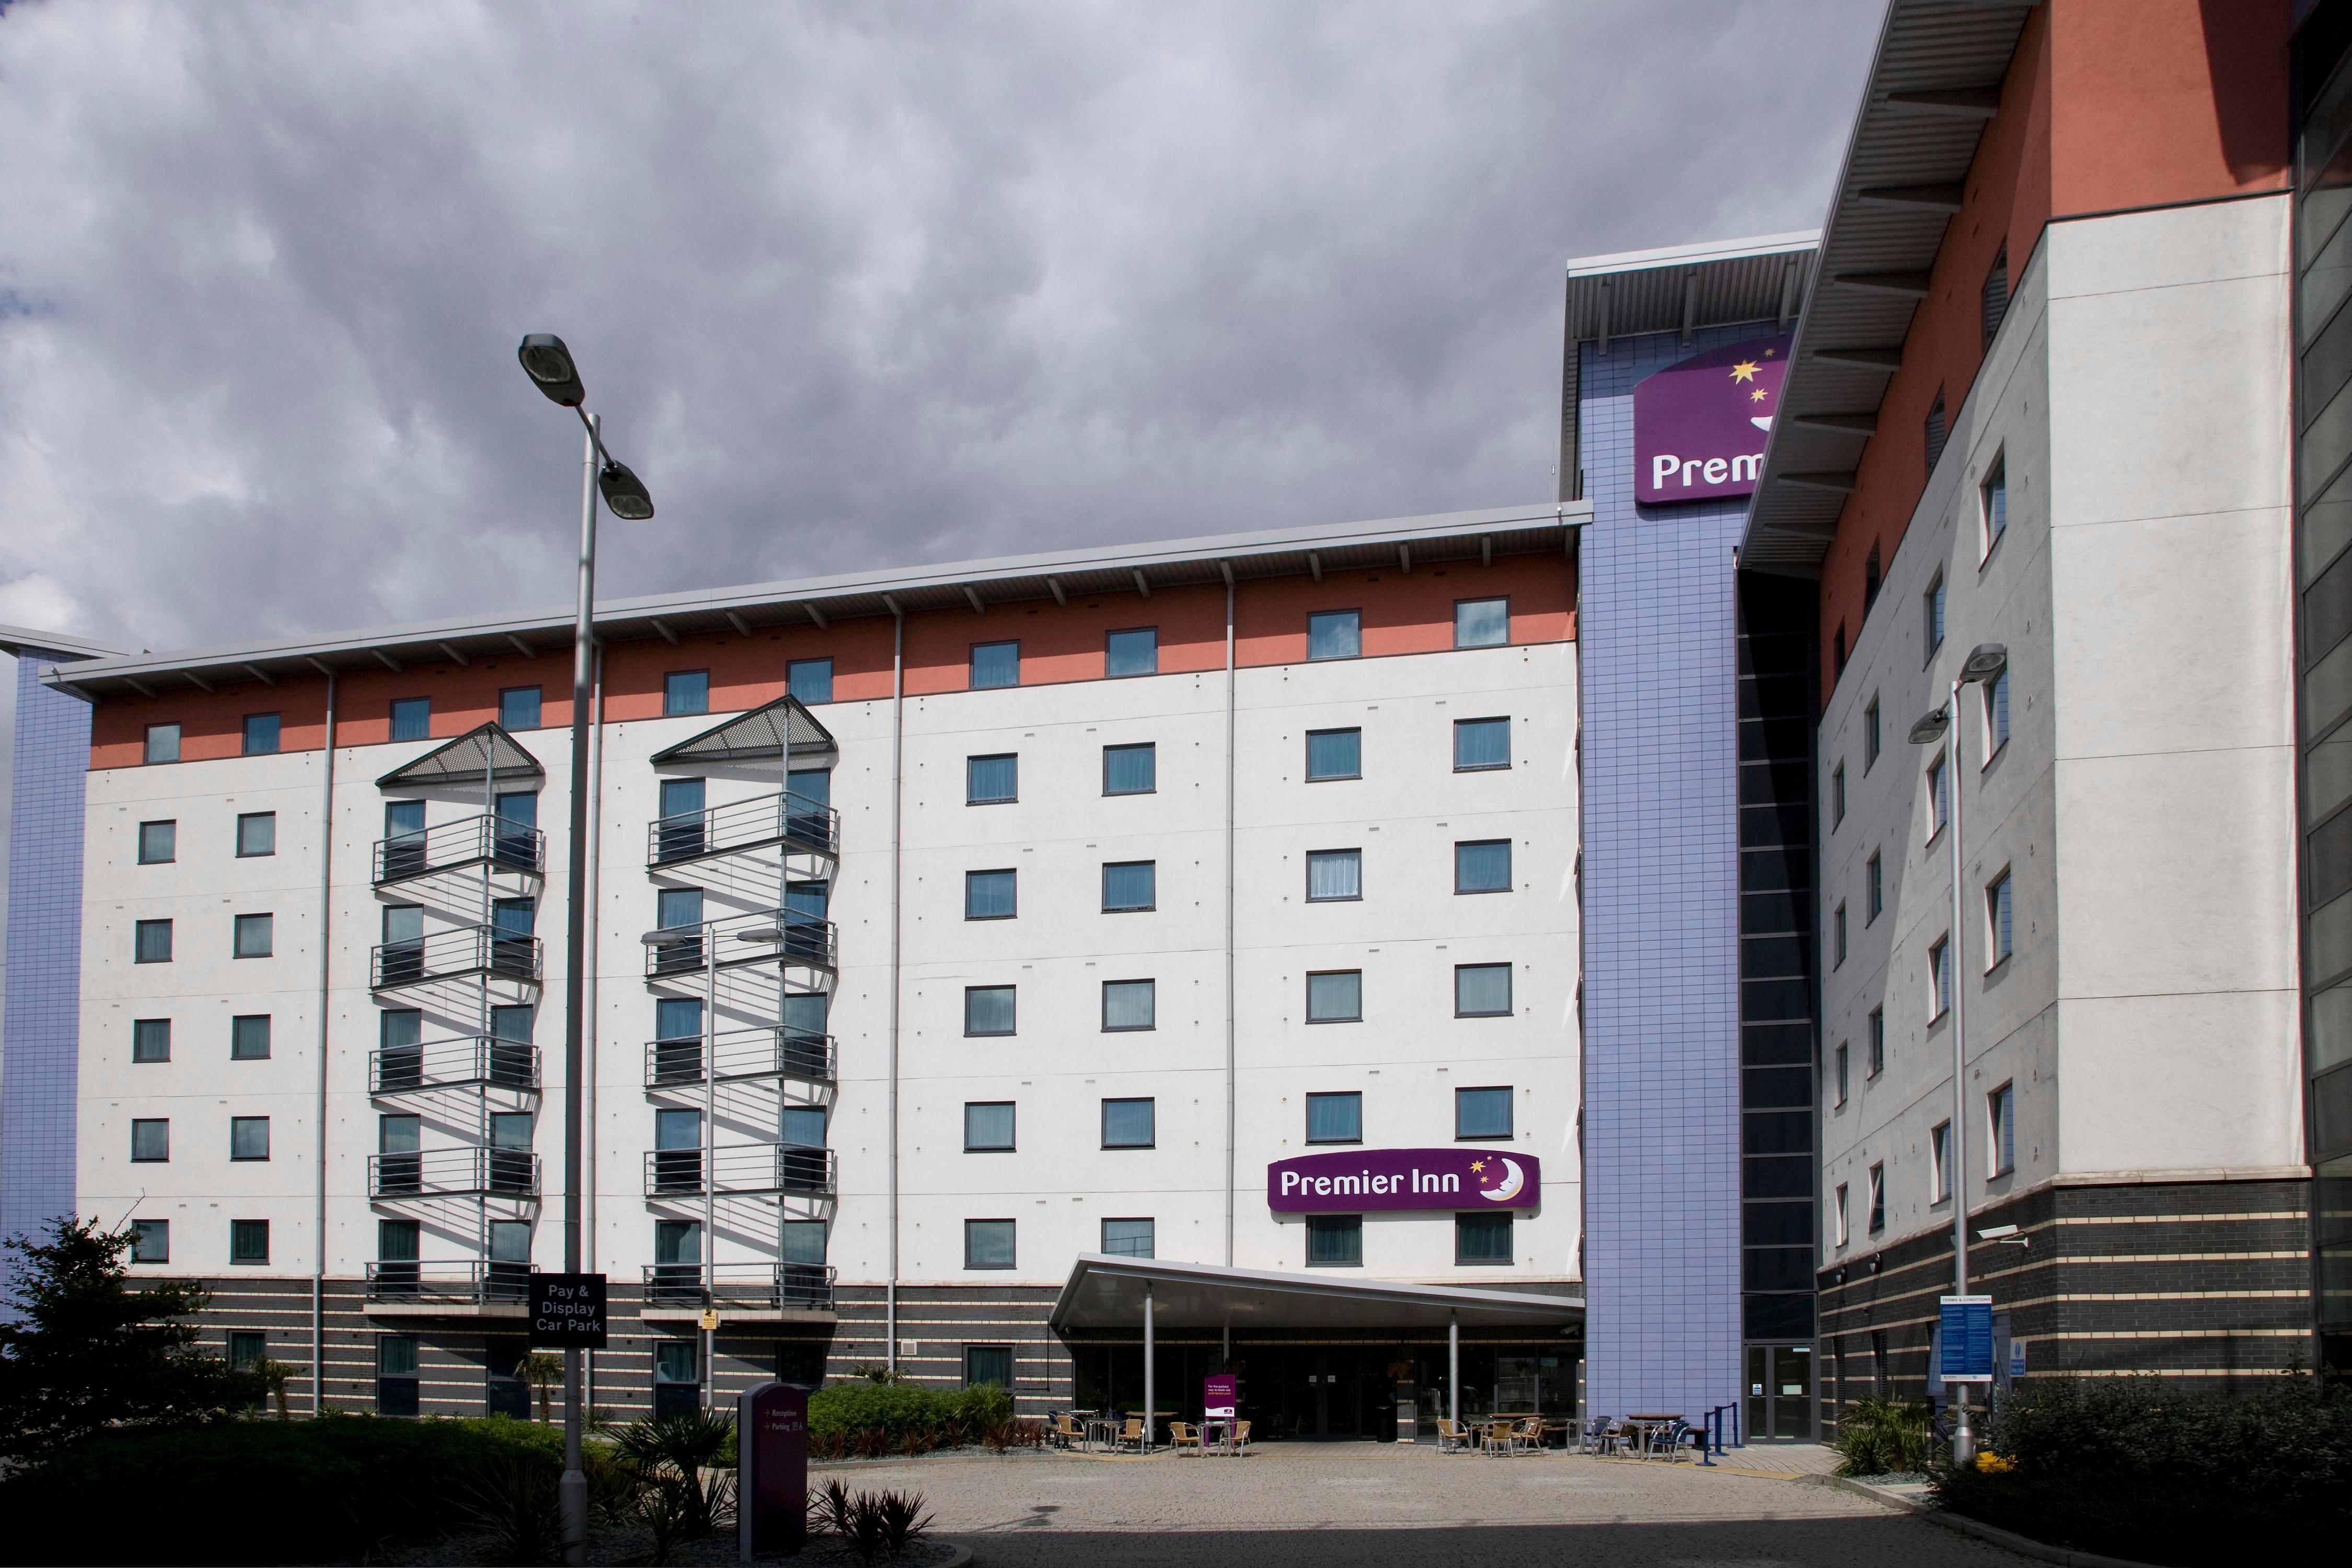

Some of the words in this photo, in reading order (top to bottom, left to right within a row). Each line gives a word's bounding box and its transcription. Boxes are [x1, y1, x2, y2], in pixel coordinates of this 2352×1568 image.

[1281, 1169, 1404, 1196] Premier
[1412, 1168, 1459, 1193] Inn
[549, 1285, 574, 1299] Pay
[579, 1285, 589, 1297] &
[543, 1301, 595, 1317] Display
[536, 1318, 562, 1331] Car
[568, 1319, 601, 1331] Park
[772, 1409, 797, 1418] Reception
[772, 1423, 790, 1432] Parking
